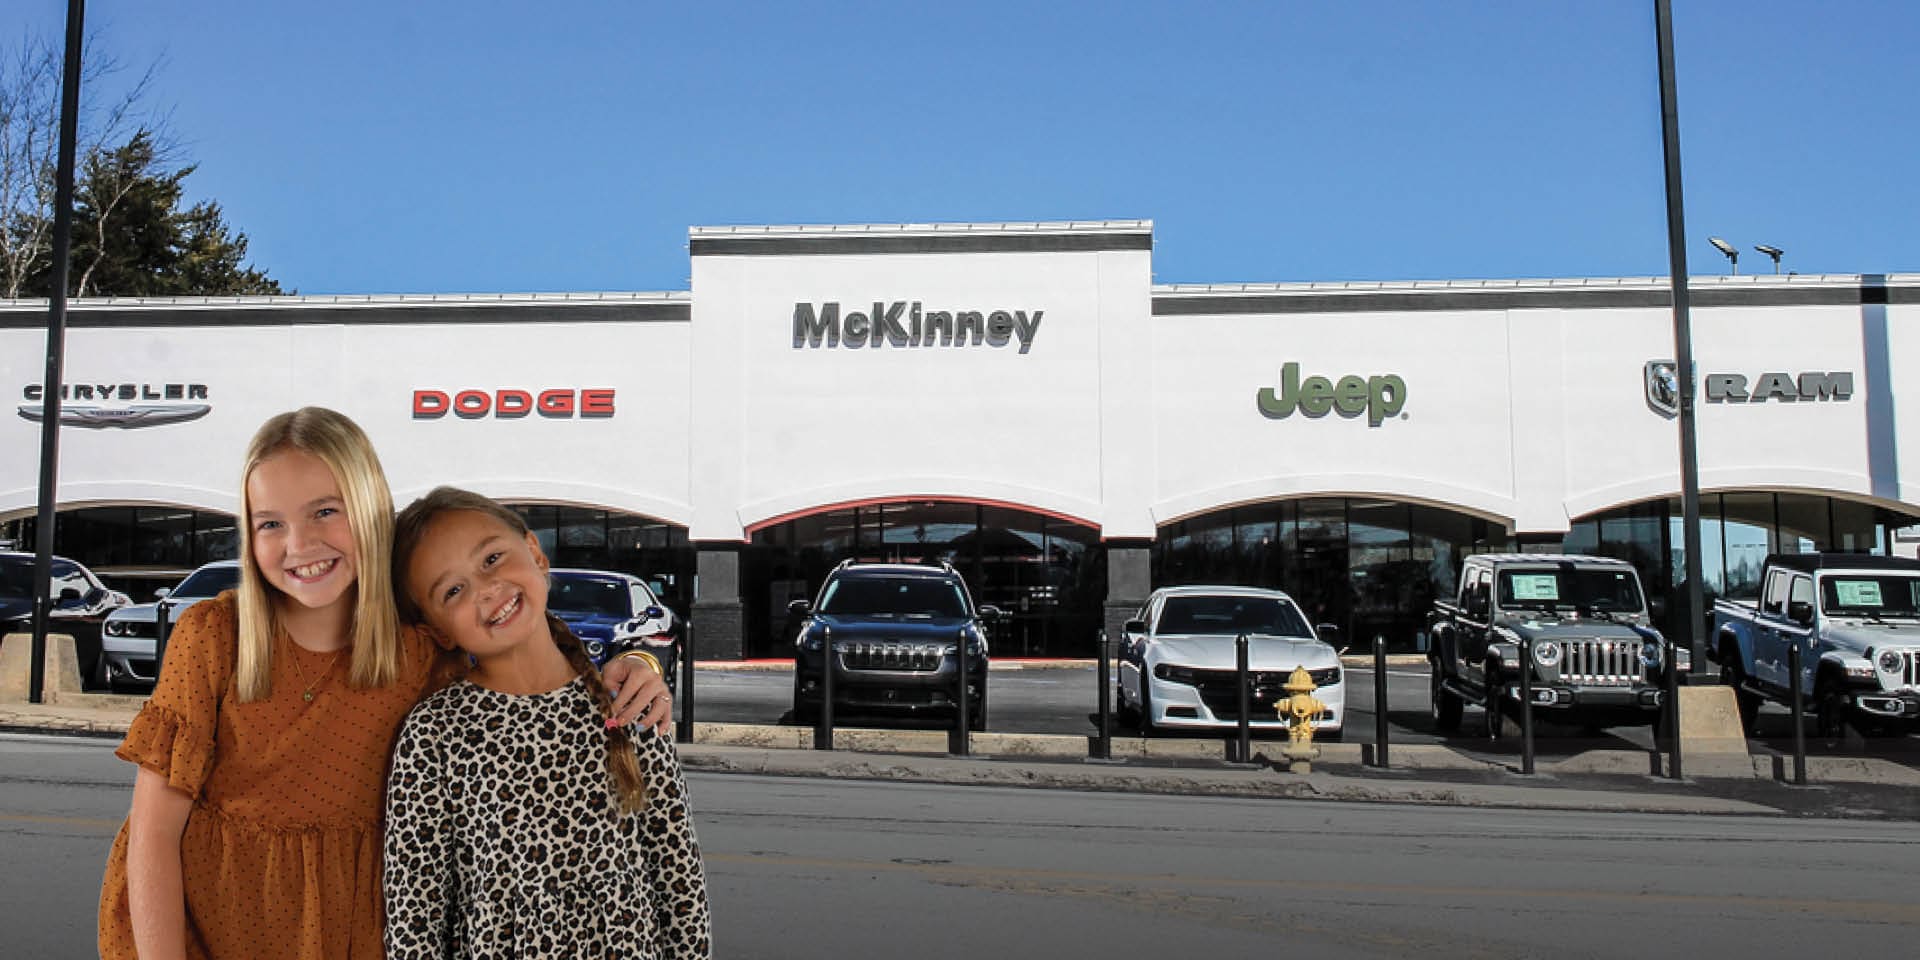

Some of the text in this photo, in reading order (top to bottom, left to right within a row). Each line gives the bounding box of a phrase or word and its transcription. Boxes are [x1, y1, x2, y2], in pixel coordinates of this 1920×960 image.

[793, 302, 1043, 354] McKinney
[413, 389, 615, 418] DODGE
[1257, 362, 1406, 427] Jeep
[1705, 372, 1853, 403] RAM
